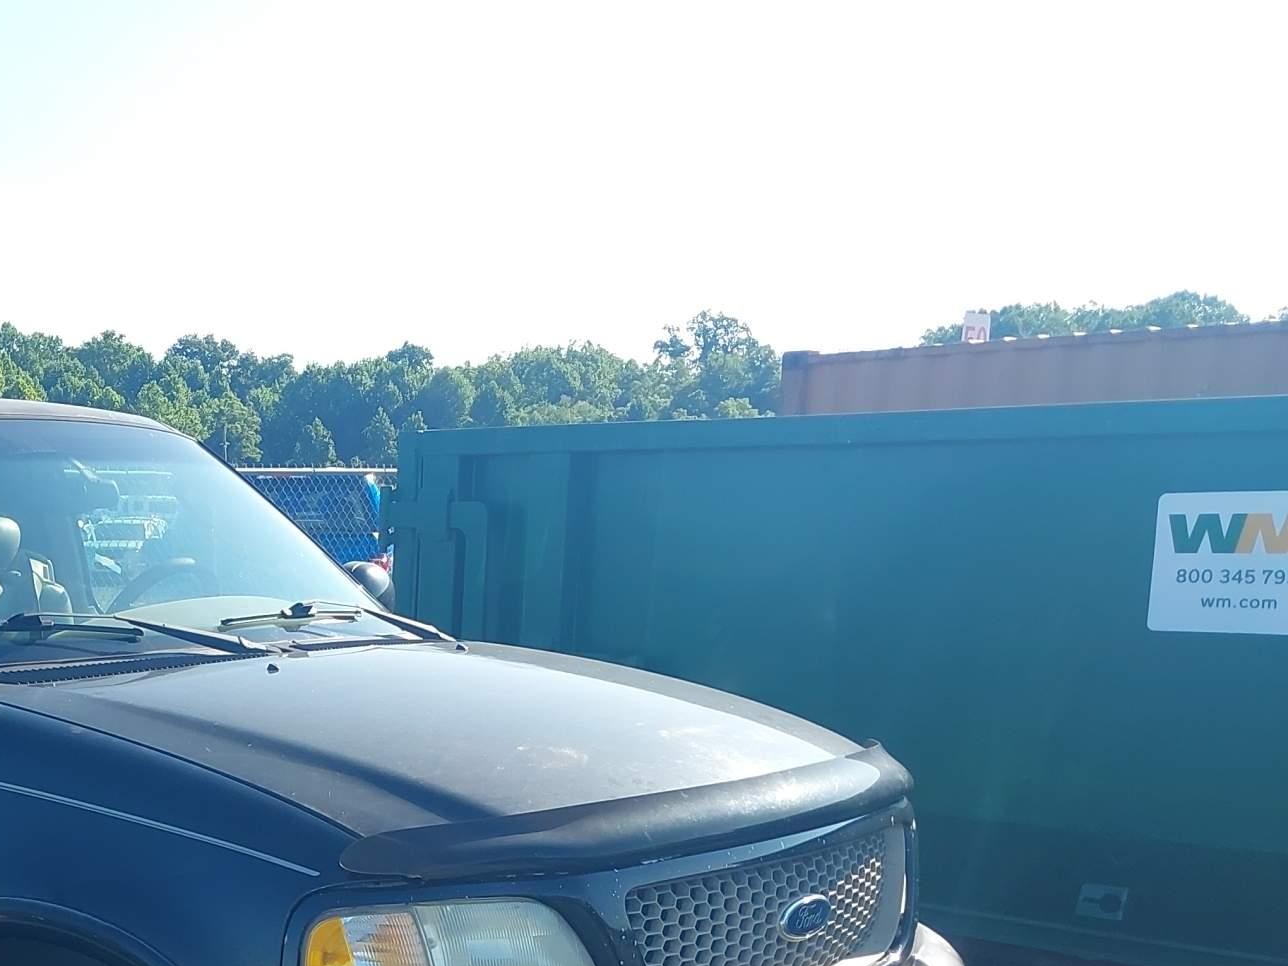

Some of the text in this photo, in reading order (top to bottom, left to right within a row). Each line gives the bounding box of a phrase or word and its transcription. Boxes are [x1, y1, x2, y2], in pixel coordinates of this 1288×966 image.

[1175, 568, 1288, 585] 800 345 79
[1200, 597, 1278, 610] wm.com
[795, 903, 824, 929] Ford
